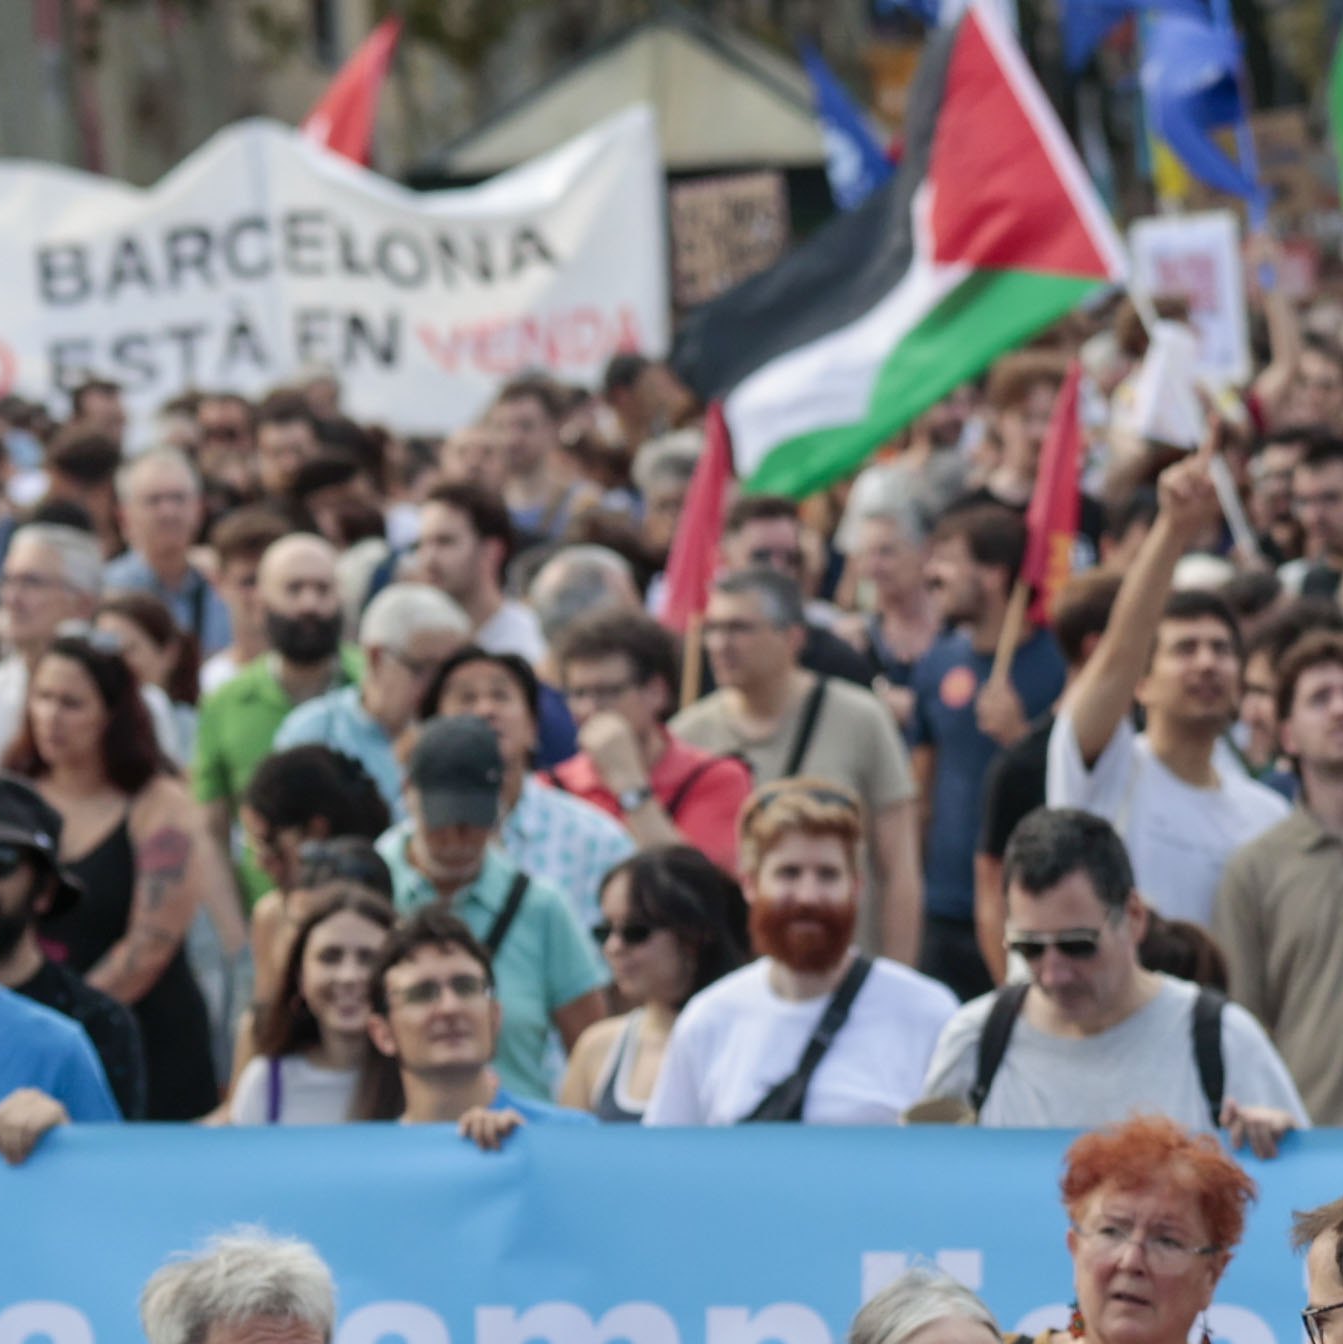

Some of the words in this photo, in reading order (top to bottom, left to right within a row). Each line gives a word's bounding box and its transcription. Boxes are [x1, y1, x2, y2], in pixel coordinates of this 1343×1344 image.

[35, 208, 560, 304] BARCELONA
[293, 313, 402, 371] EN
[415, 302, 645, 377] VENDA
